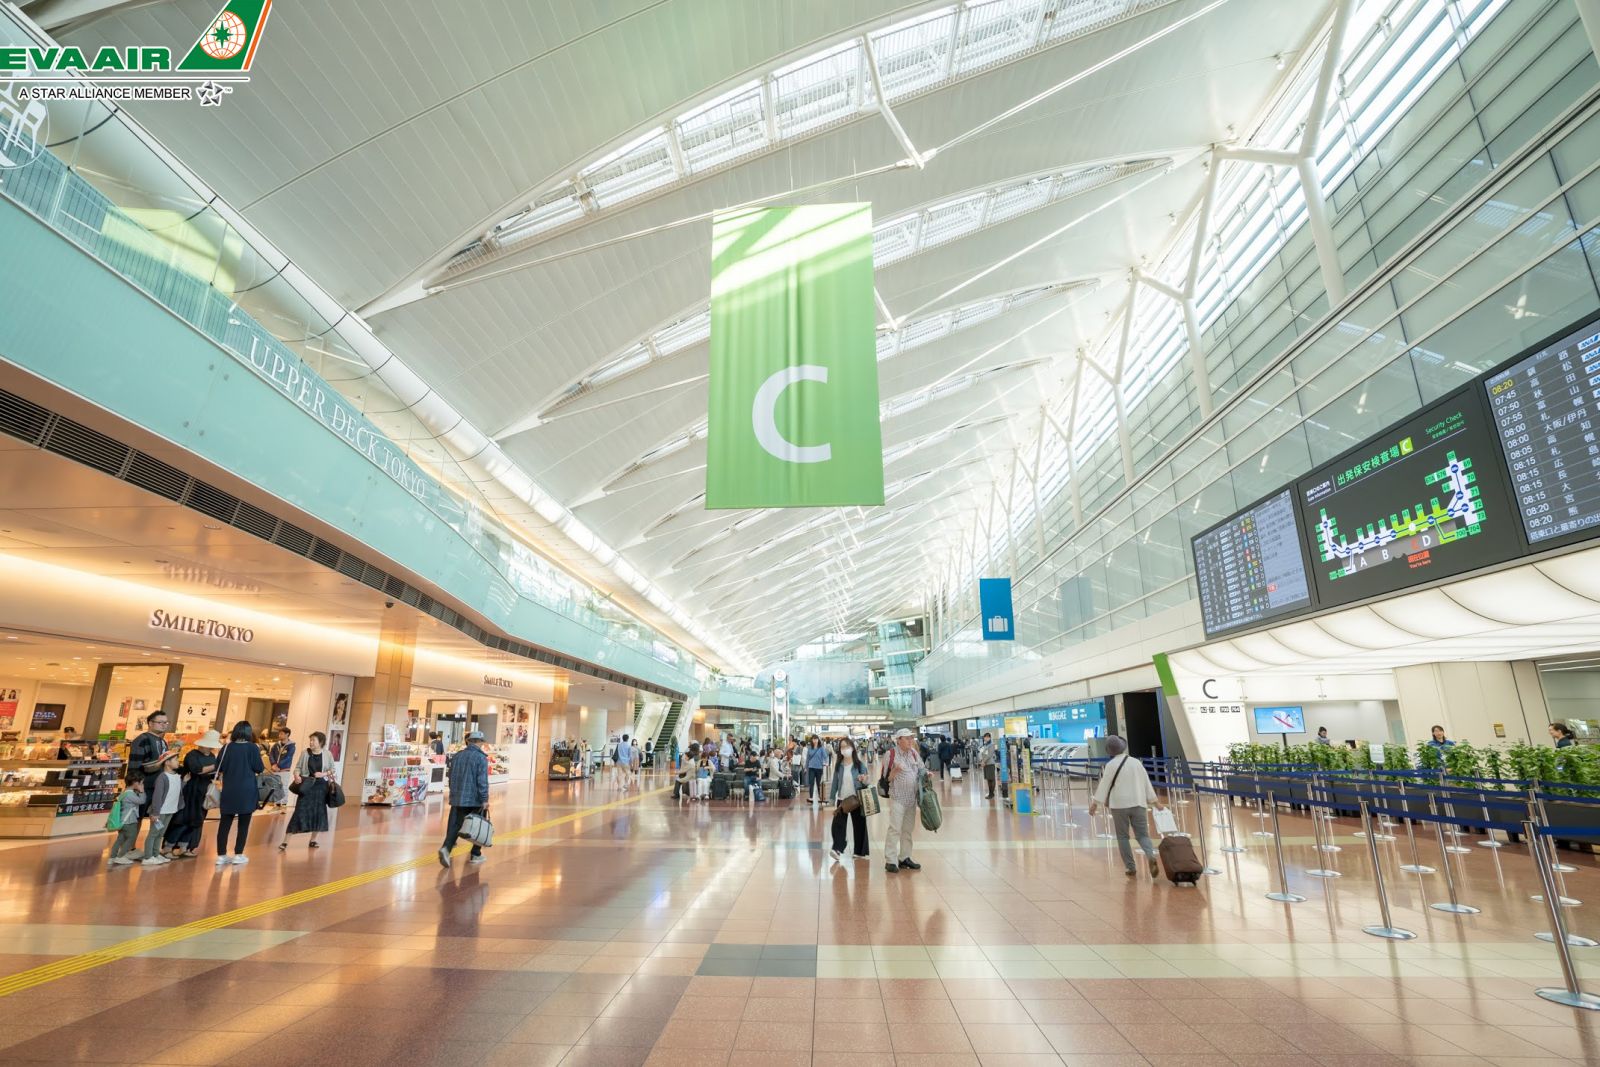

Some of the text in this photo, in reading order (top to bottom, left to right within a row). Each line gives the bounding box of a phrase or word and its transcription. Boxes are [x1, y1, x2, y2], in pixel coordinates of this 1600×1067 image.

[1492, 379, 1514, 395] 08:20
[1495, 390, 1516, 405] 07:45
[752, 364, 832, 464] C
[1498, 401, 1519, 416] 07:50
[250, 336, 427, 500] UPPER DECK TOKYO
[1425, 420, 1445, 435] Security
[1445, 412, 1463, 424] Check
[1501, 412, 1522, 427] 07:55
[1505, 423, 1526, 438] 08:00
[1507, 434, 1529, 448] 08:00
[1511, 445, 1532, 460] 08:05
[1337, 439, 1411, 486] 出発保安検査場 C
[1514, 457, 1536, 471] 08:15
[1517, 468, 1539, 482] 08:15
[1520, 480, 1542, 493] 08:15
[1523, 491, 1546, 504] 08:15
[1526, 503, 1549, 516] 08:20
[1530, 515, 1552, 528] 08:20
[1422, 535, 1431, 547] D
[1360, 557, 1367, 567] A
[1382, 549, 1388, 560] B
[1202, 679, 1218, 699] C
